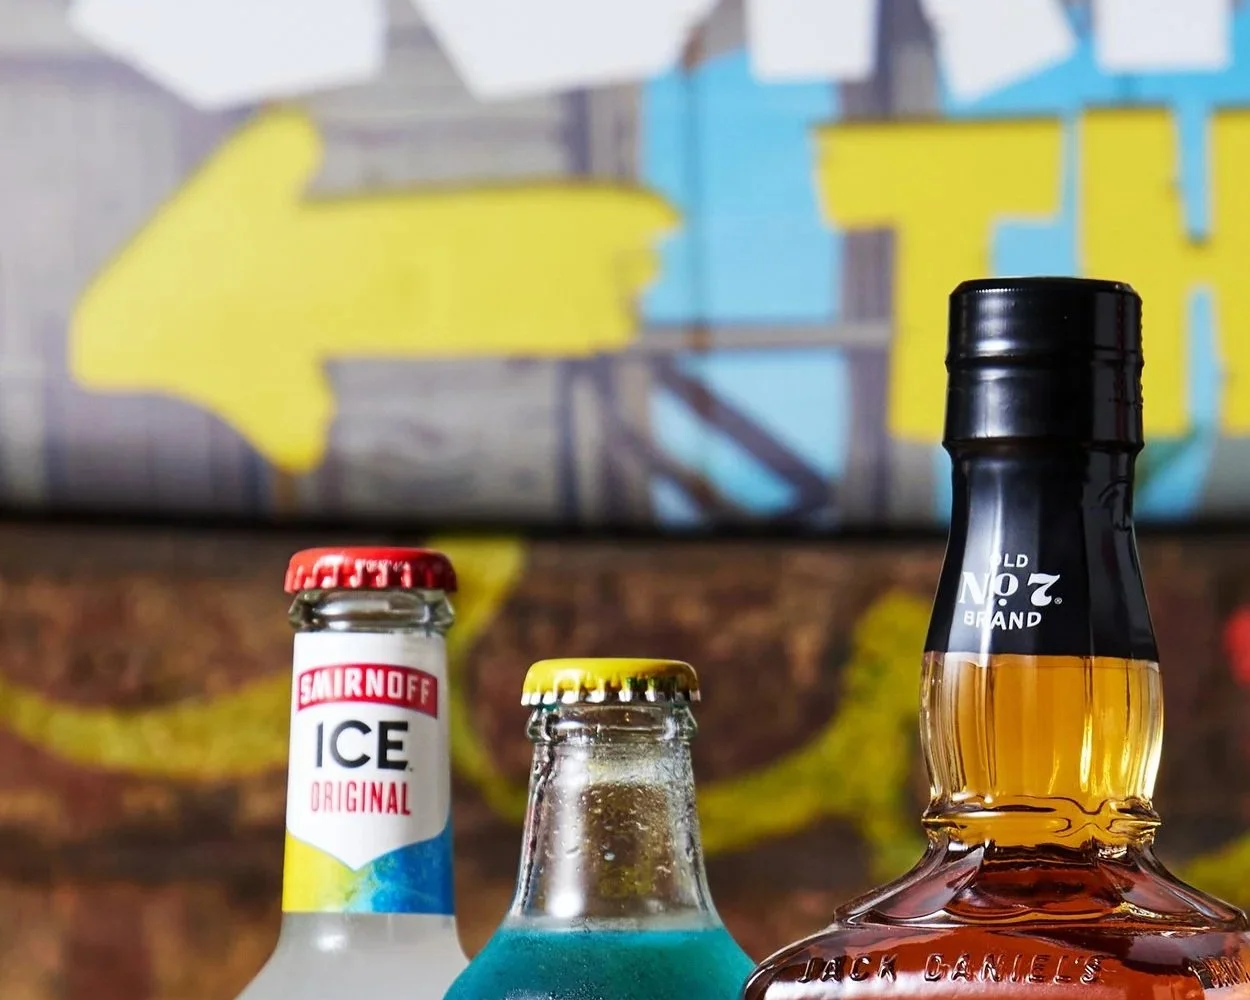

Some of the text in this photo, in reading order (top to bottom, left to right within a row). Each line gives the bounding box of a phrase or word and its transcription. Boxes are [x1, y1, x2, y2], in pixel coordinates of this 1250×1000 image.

[964, 612, 1042, 630] BRAND
[300, 668, 432, 704] SMIRNOFF
[316, 720, 408, 770] ICE
[311, 781, 411, 815] ORIGINAL
[797, 951, 1103, 985] JACK DANIEL'S
